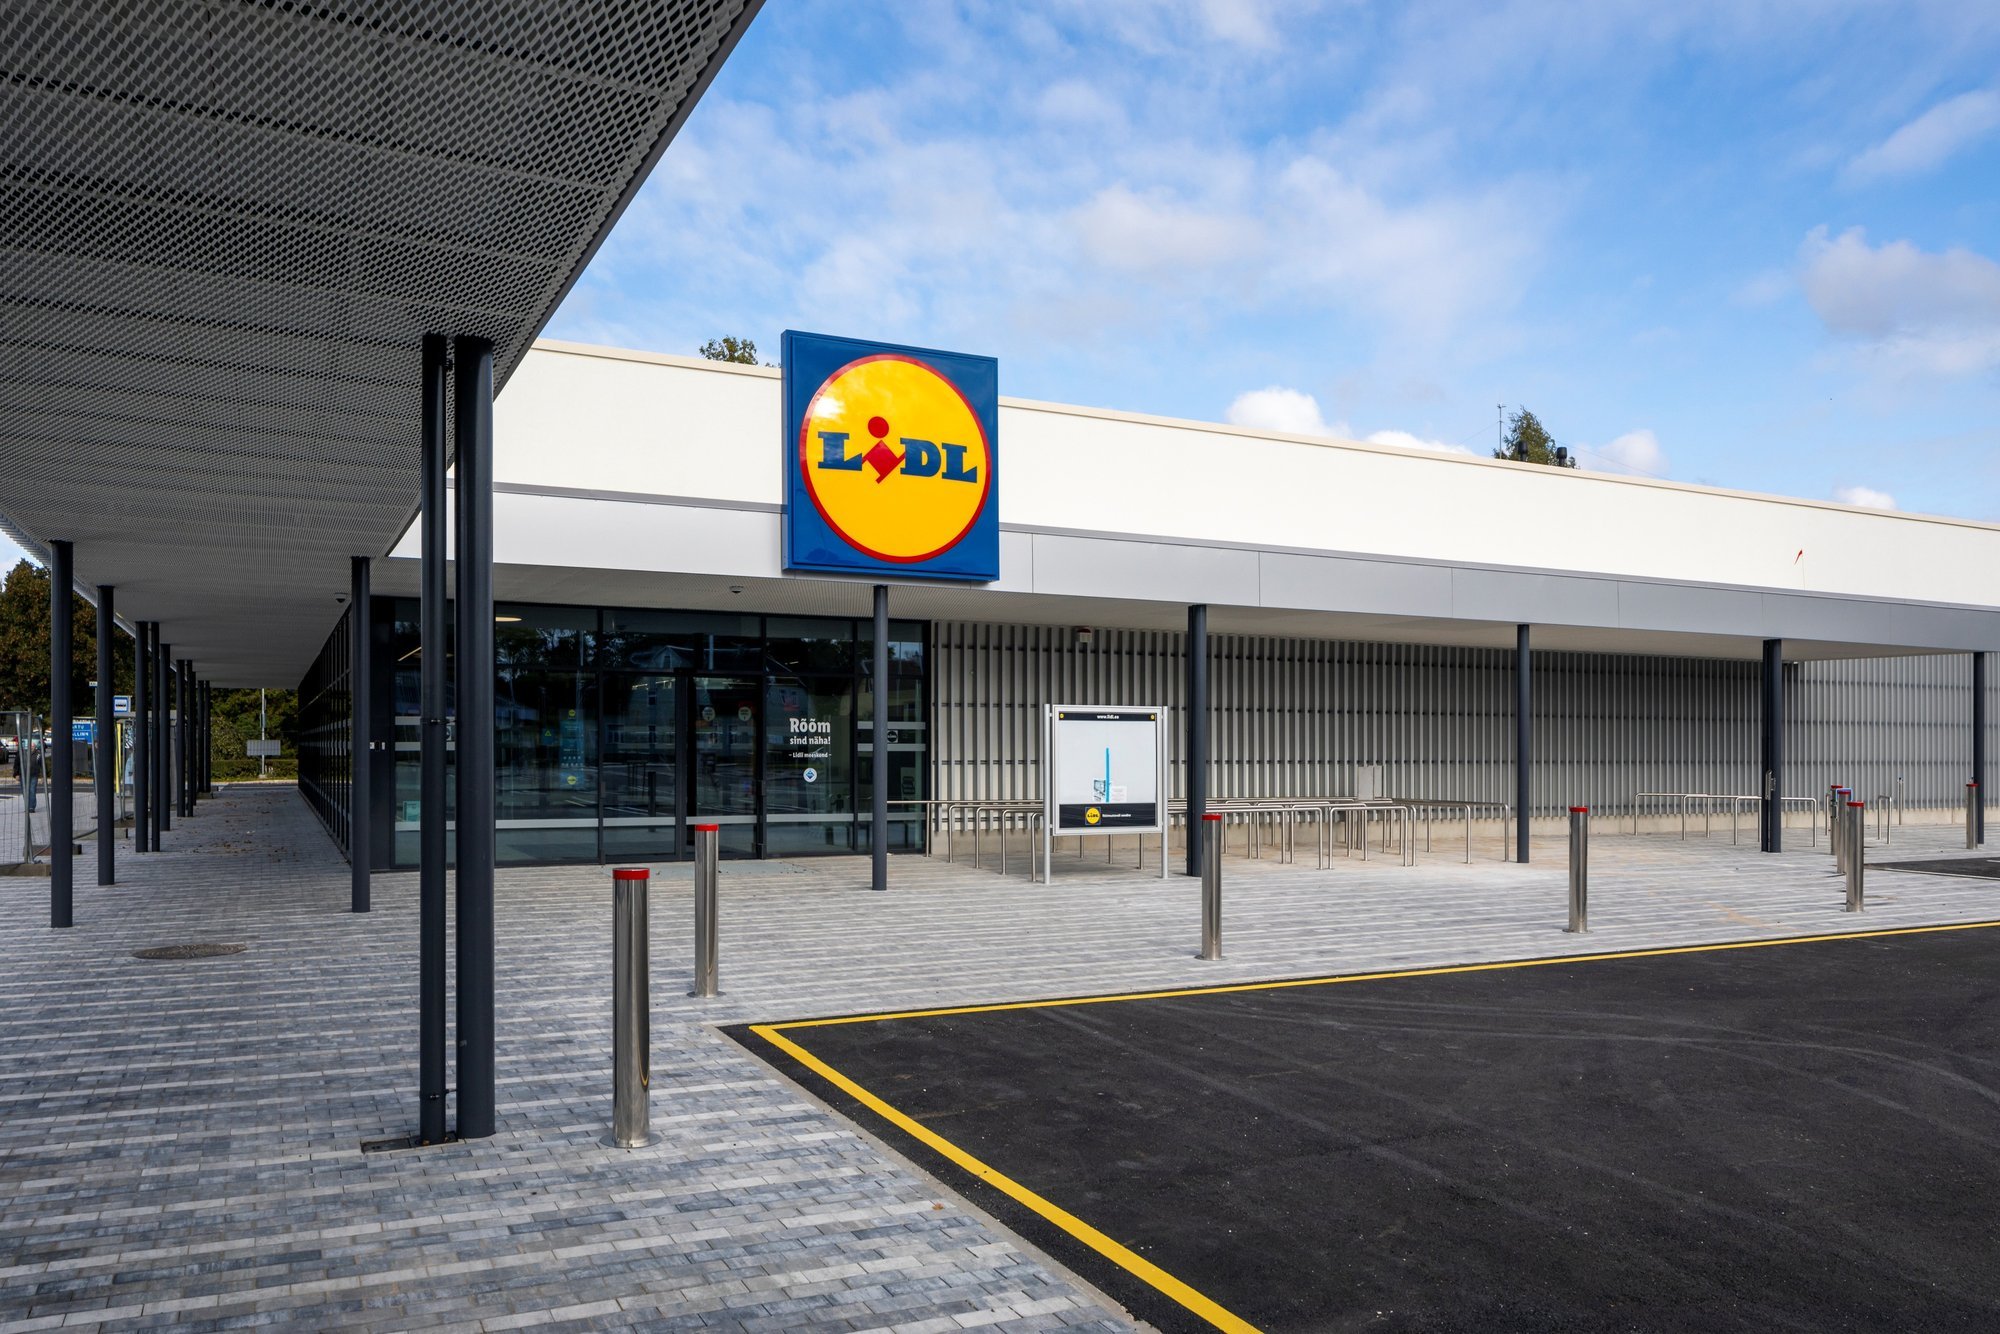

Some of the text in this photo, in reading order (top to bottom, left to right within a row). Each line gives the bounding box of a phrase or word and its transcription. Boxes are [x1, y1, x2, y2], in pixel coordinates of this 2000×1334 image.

[789, 717, 831, 733] Rõõm
[790, 736, 831, 745] sind näha!
